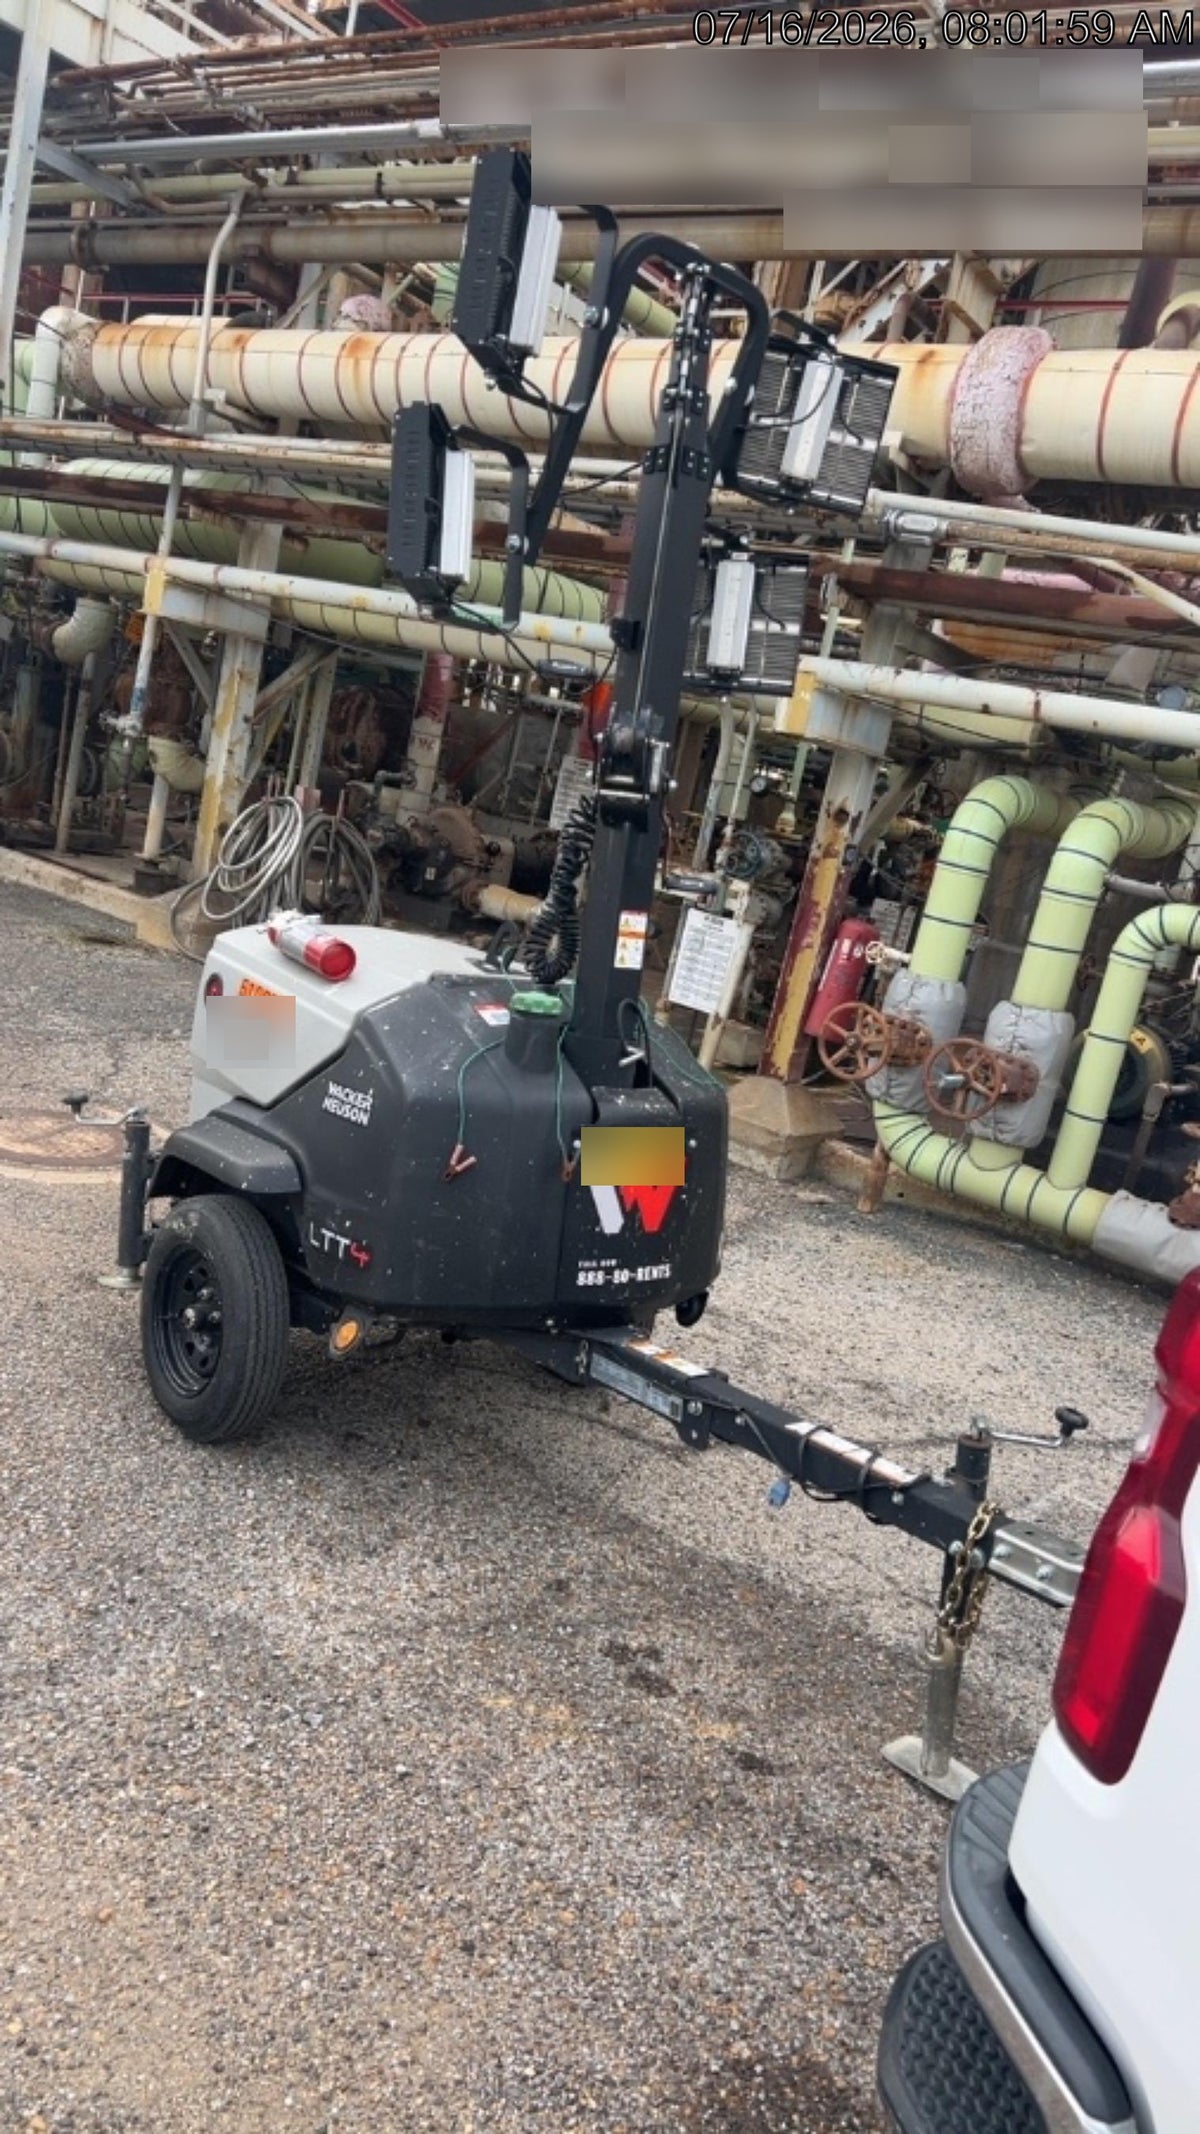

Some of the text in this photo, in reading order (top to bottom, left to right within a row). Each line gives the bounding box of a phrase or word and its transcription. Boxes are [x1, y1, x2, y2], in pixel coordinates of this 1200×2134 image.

[328, 1081, 373, 1111] WACKER
[322, 1097, 371, 1126] NEUSON
[310, 1221, 371, 1268] LTT4
